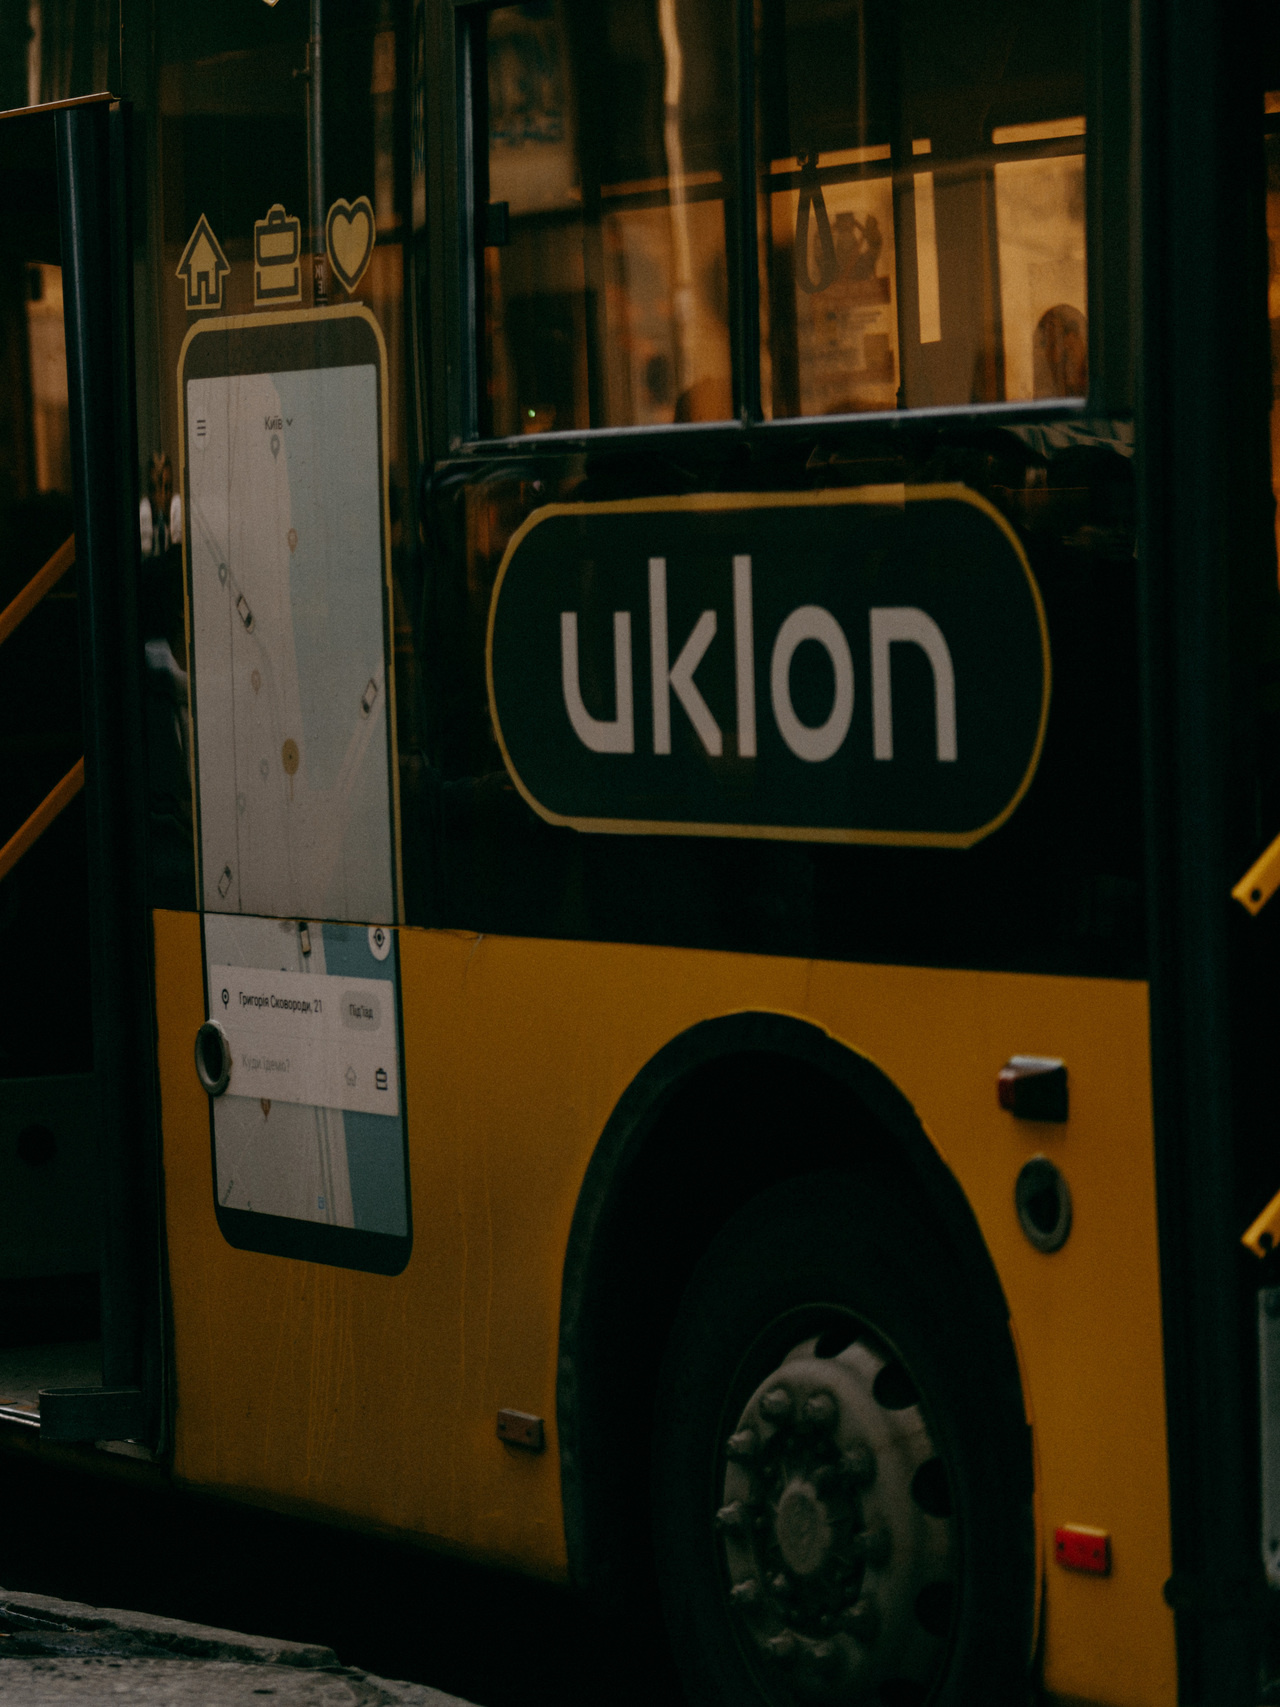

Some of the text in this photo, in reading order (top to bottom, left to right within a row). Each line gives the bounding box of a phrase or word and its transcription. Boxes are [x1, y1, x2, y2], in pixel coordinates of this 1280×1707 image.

[264, 415, 283, 430] Київ
[560, 555, 956, 762] uklon
[239, 992, 269, 1009] Григорія
[314, 1000, 322, 1013] 21
